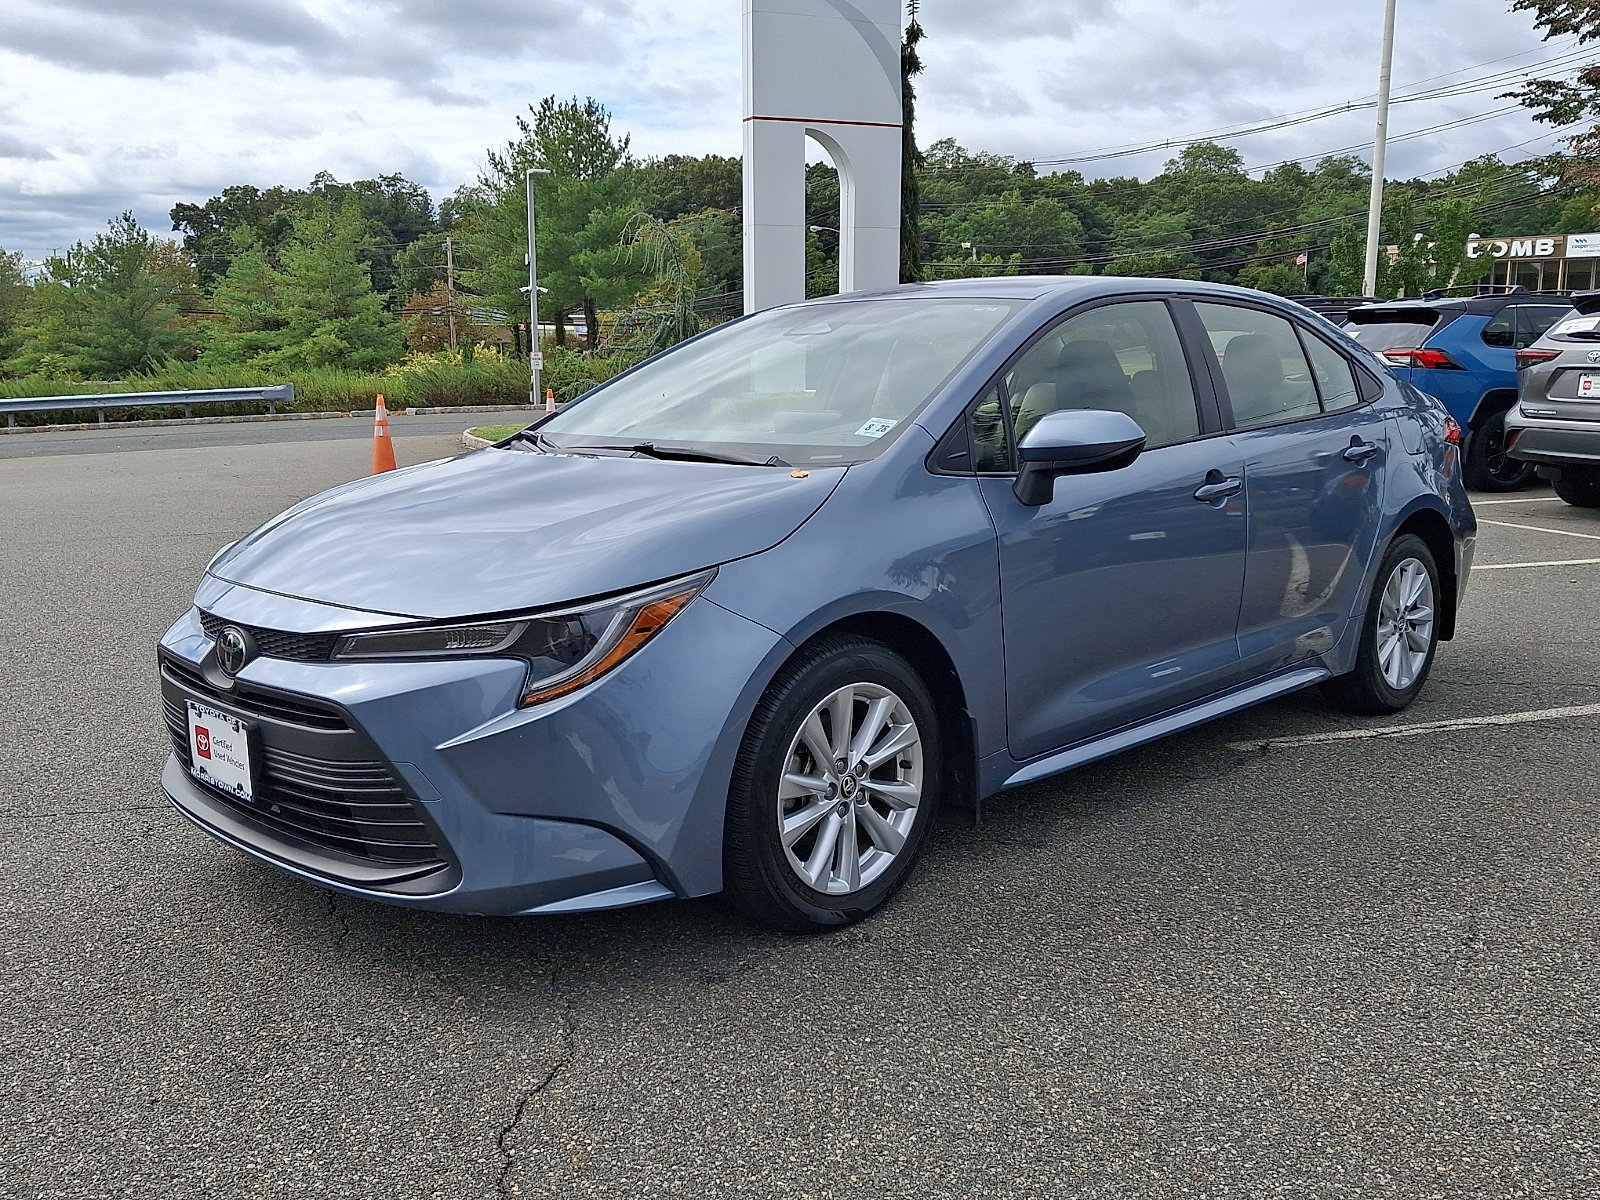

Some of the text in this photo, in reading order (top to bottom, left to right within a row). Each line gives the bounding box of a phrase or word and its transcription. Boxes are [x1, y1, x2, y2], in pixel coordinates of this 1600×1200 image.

[194, 703, 225, 721] TOYOTA
[212, 736, 233, 752] Certified
[213, 748, 245, 771] Used Vehicles
